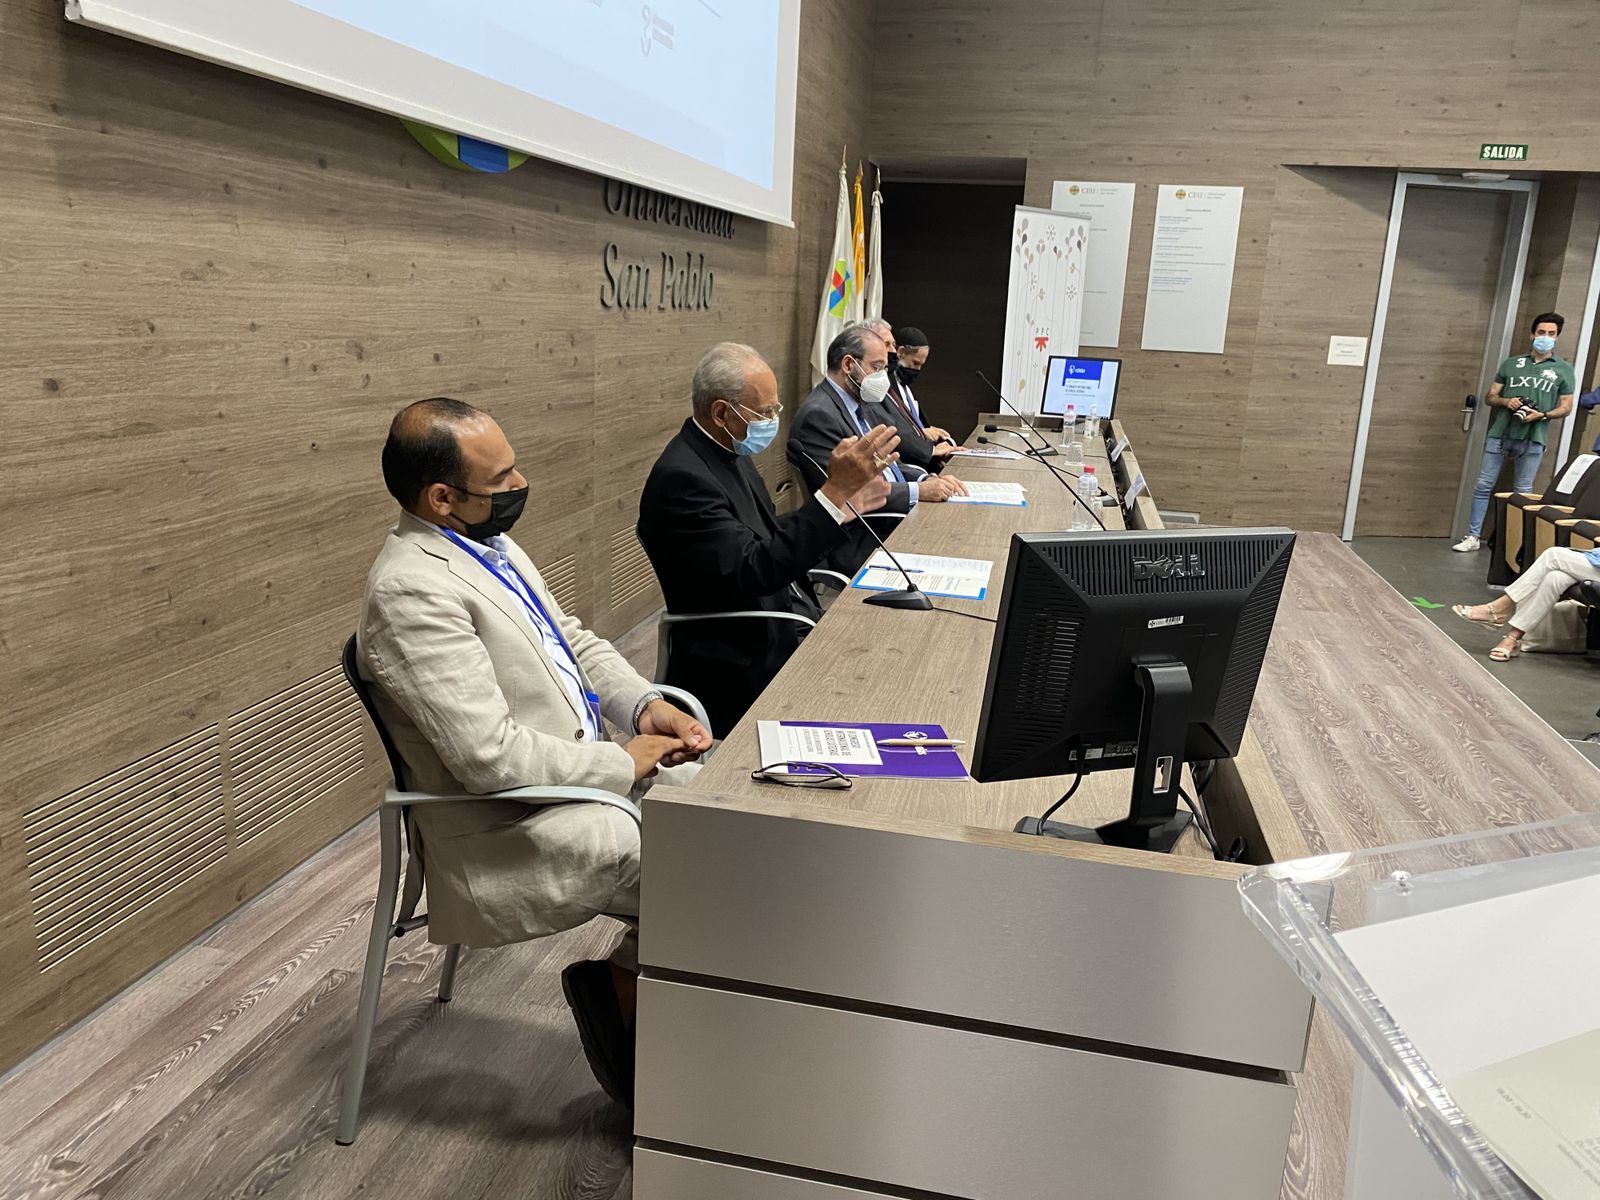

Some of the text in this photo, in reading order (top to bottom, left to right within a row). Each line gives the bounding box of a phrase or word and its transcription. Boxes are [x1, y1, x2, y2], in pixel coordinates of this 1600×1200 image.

[1483, 146, 1524, 159] SALIDA
[600, 241, 714, 311] San Pablo
[1515, 357, 1527, 369] 3
[1509, 376, 1554, 393] LXVII
[1132, 554, 1206, 580] DELL
